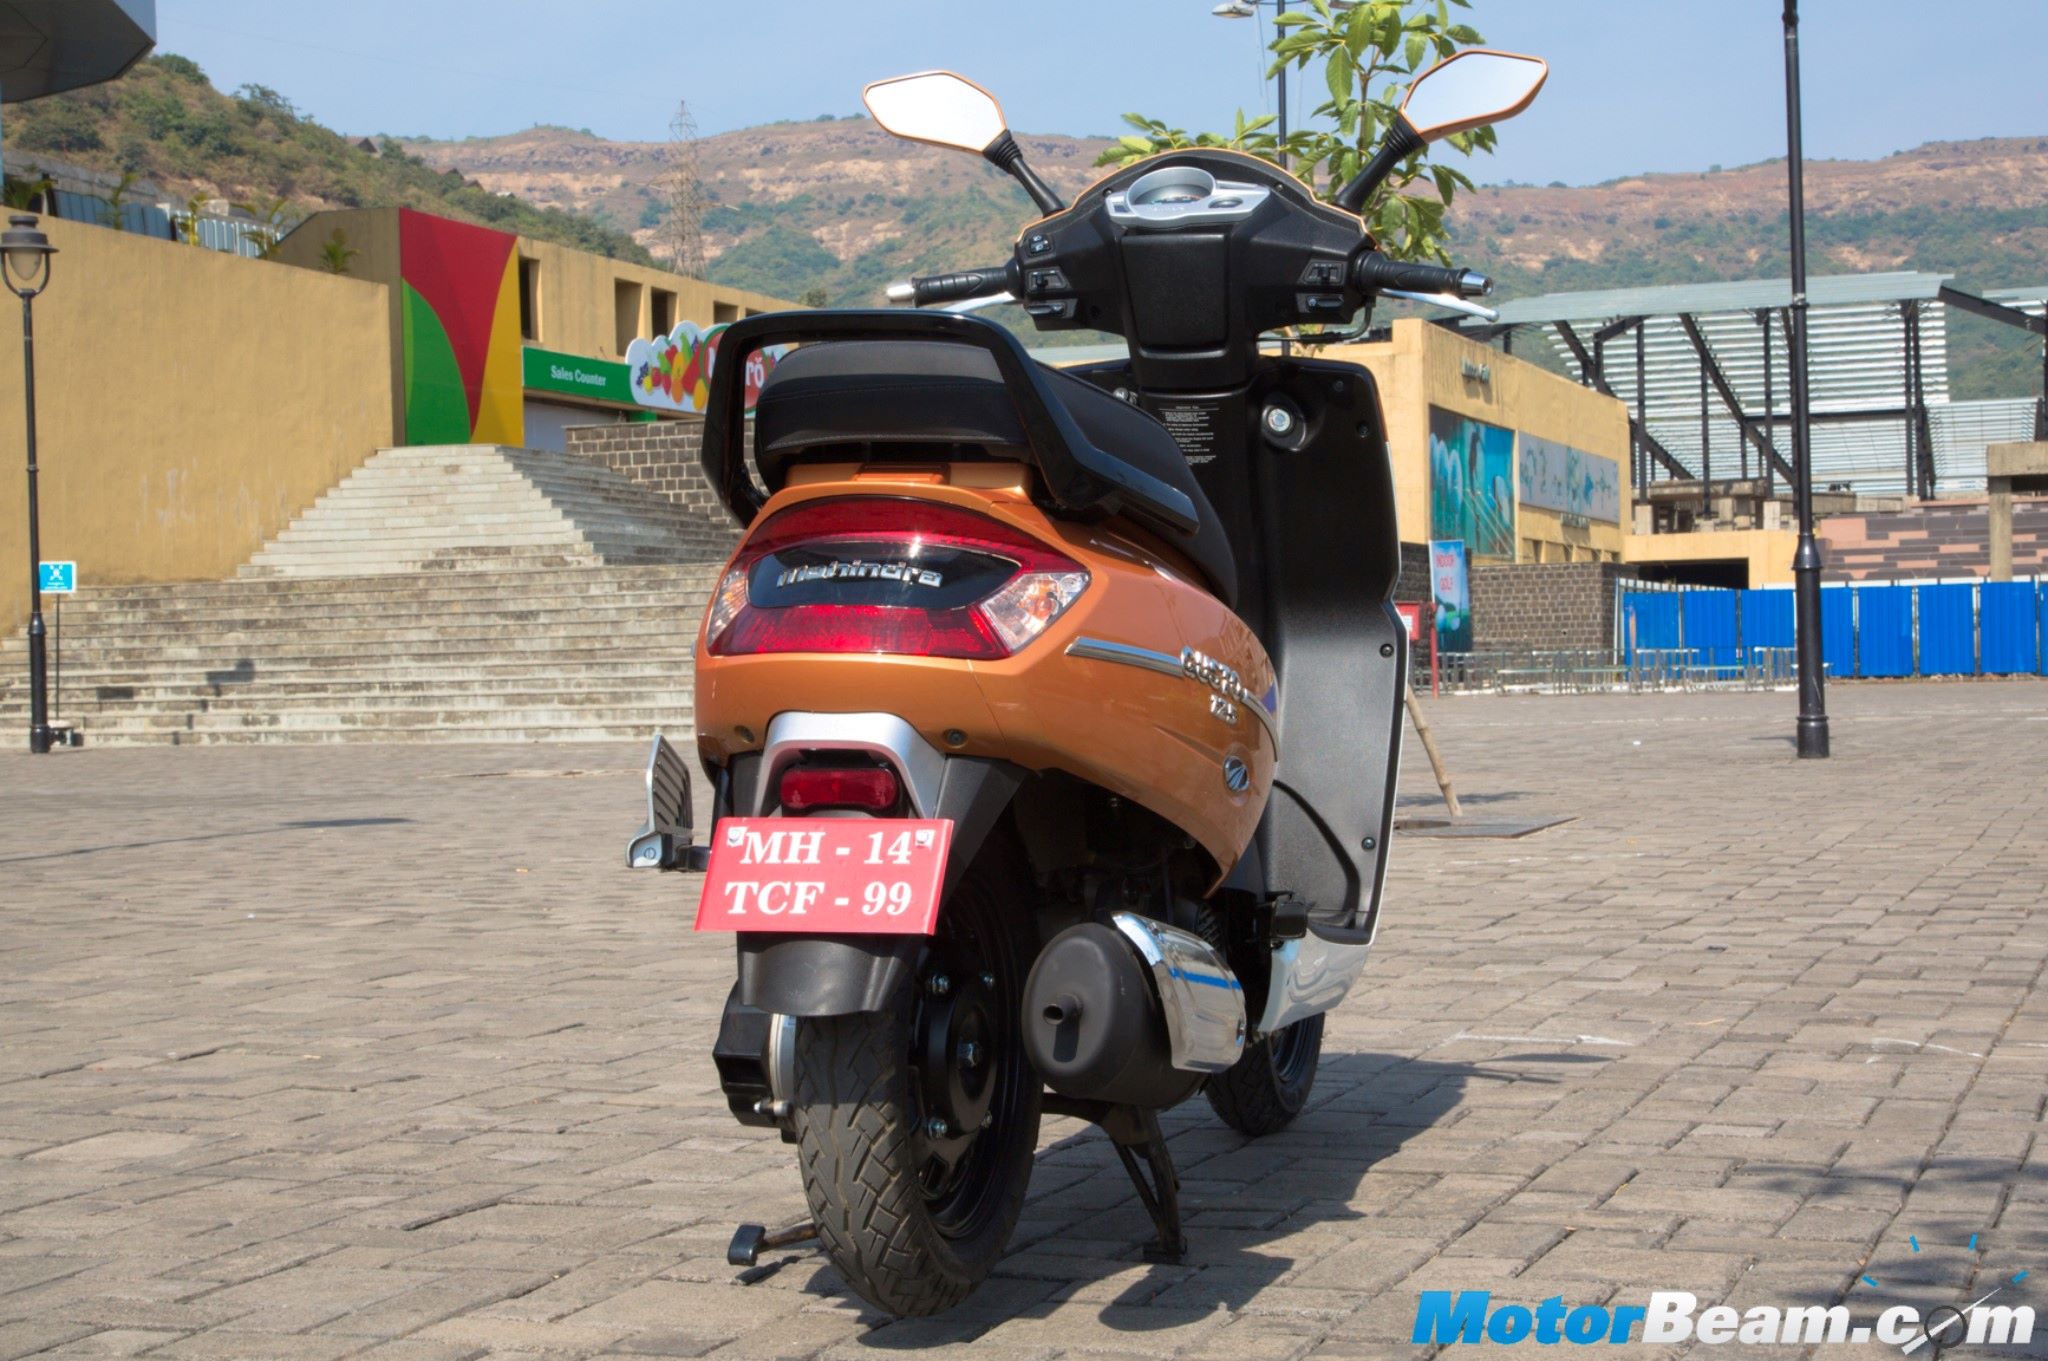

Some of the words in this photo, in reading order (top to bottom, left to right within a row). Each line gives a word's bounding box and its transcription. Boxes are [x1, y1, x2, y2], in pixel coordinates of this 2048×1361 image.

[551, 365, 573, 381] Sales
[574, 368, 606, 386] Counter
[776, 559, 943, 588] mahindra
[739, 831, 826, 865] MH
[863, 831, 912, 865] 14
[724, 881, 826, 915] TCF
[861, 881, 912, 916] 99
